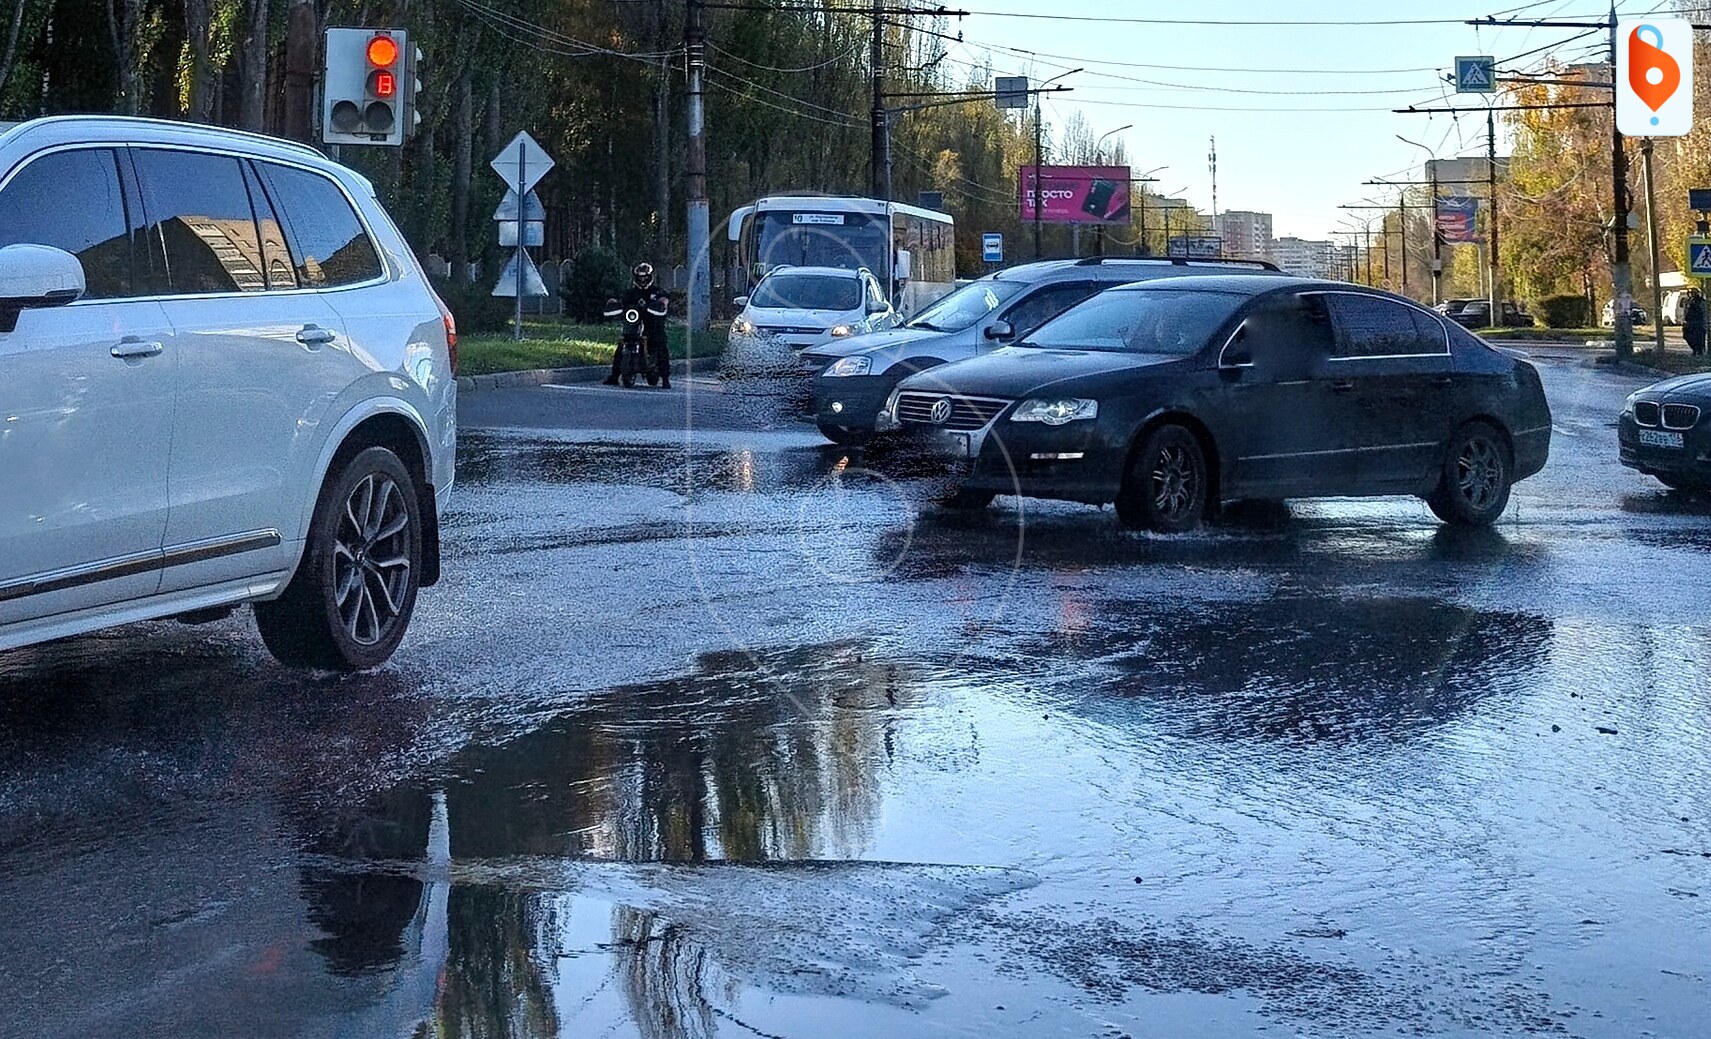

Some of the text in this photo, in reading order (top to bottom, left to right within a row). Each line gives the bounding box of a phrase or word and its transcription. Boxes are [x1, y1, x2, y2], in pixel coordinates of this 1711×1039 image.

[378, 75, 392, 94] 13
[1026, 190, 1073, 199] ПОСТО
[1026, 199, 1048, 207] ТК
